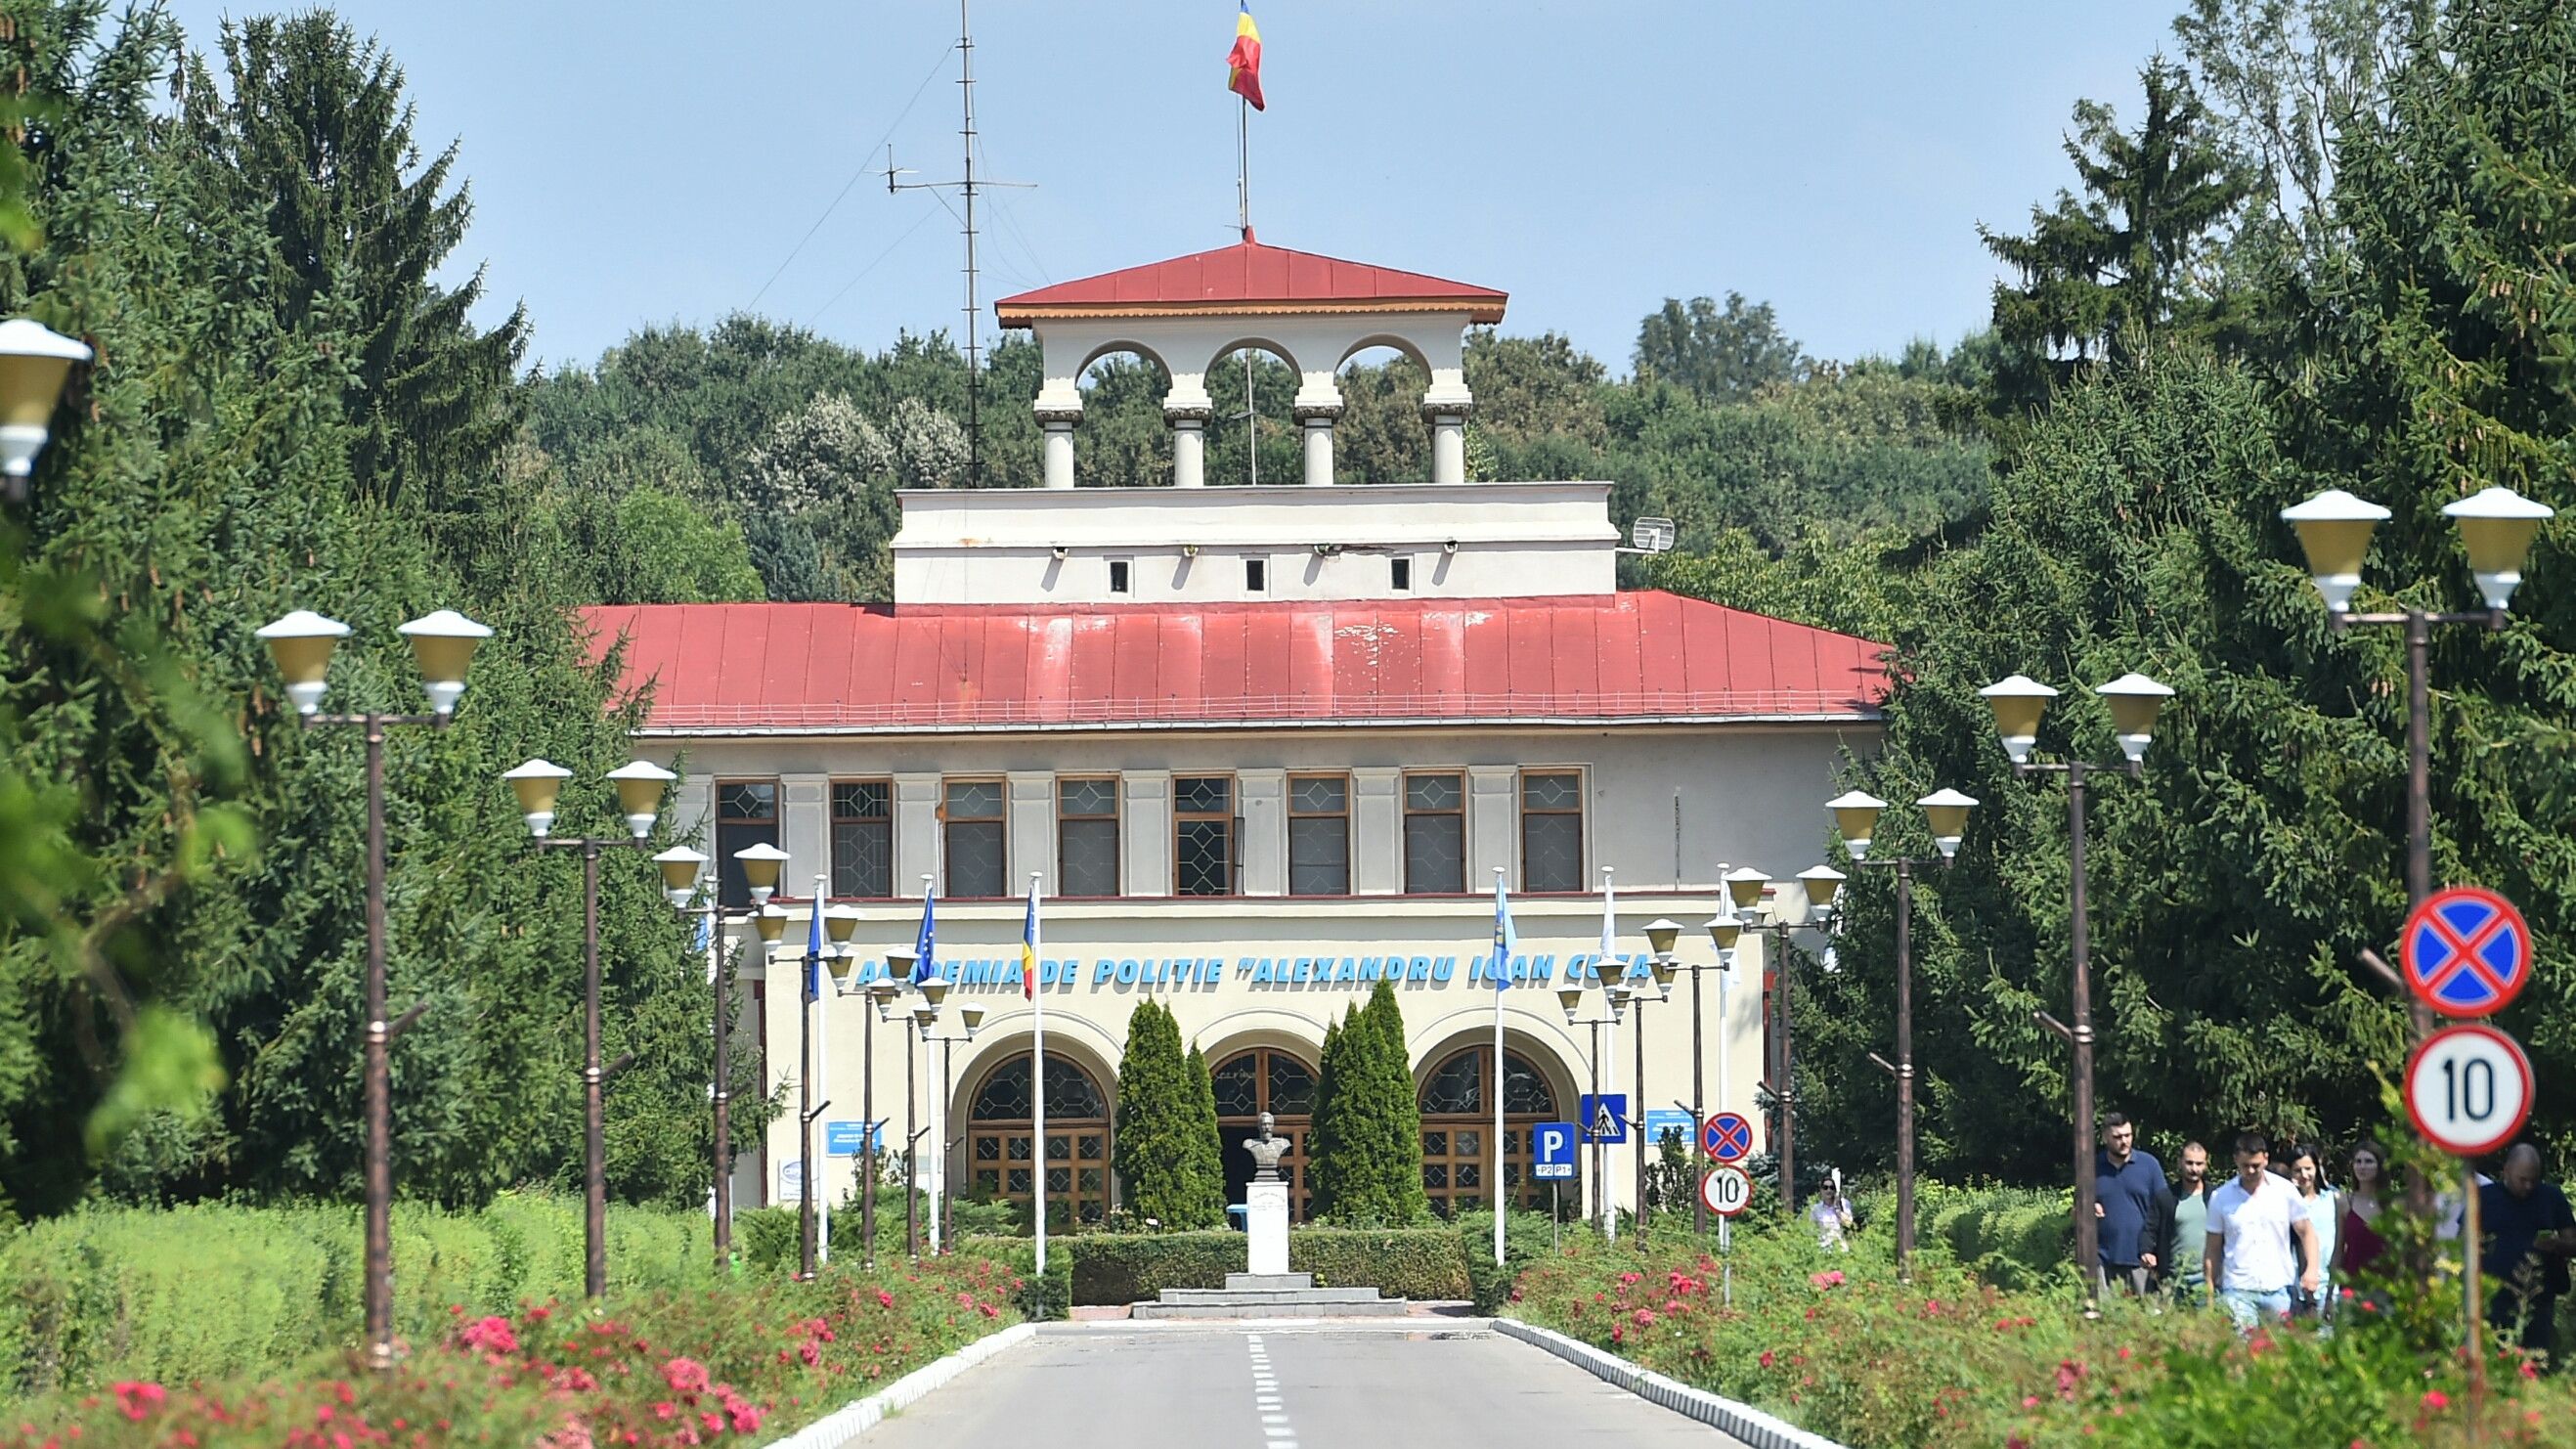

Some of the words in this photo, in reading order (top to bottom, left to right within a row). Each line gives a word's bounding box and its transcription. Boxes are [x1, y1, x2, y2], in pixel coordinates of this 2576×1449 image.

[855, 959, 1024, 985] AEMIA
[1038, 959, 1079, 985] DE
[1093, 958, 1224, 985] POLITIE
[2442, 1058, 2494, 1122] 10
[1544, 1130, 1563, 1163] P
[1717, 1176, 1739, 1204] 10
